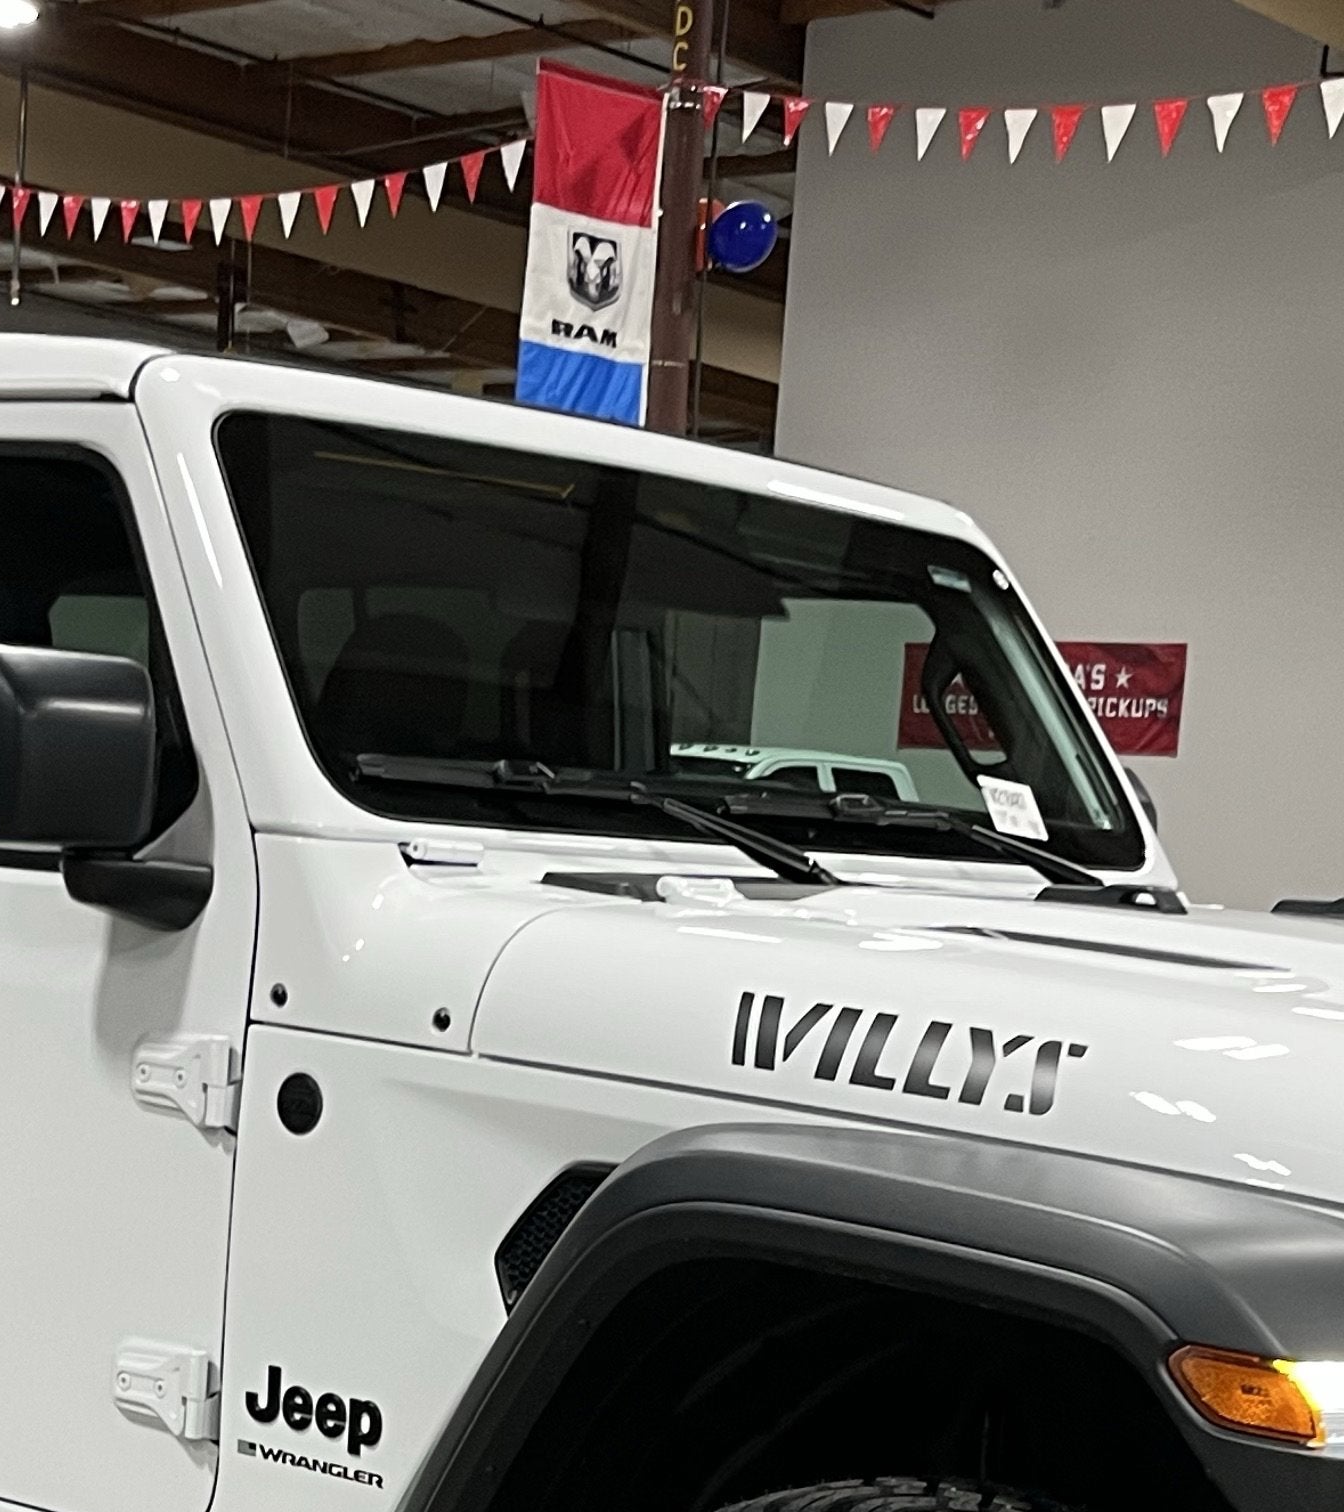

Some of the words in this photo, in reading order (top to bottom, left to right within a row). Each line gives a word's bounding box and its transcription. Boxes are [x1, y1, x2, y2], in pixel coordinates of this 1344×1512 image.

[551, 318, 618, 349] RAM
[731, 990, 1089, 1116] WILLYS
[245, 1364, 383, 1458] Jeep
[259, 1443, 384, 1489] WRANGLER
